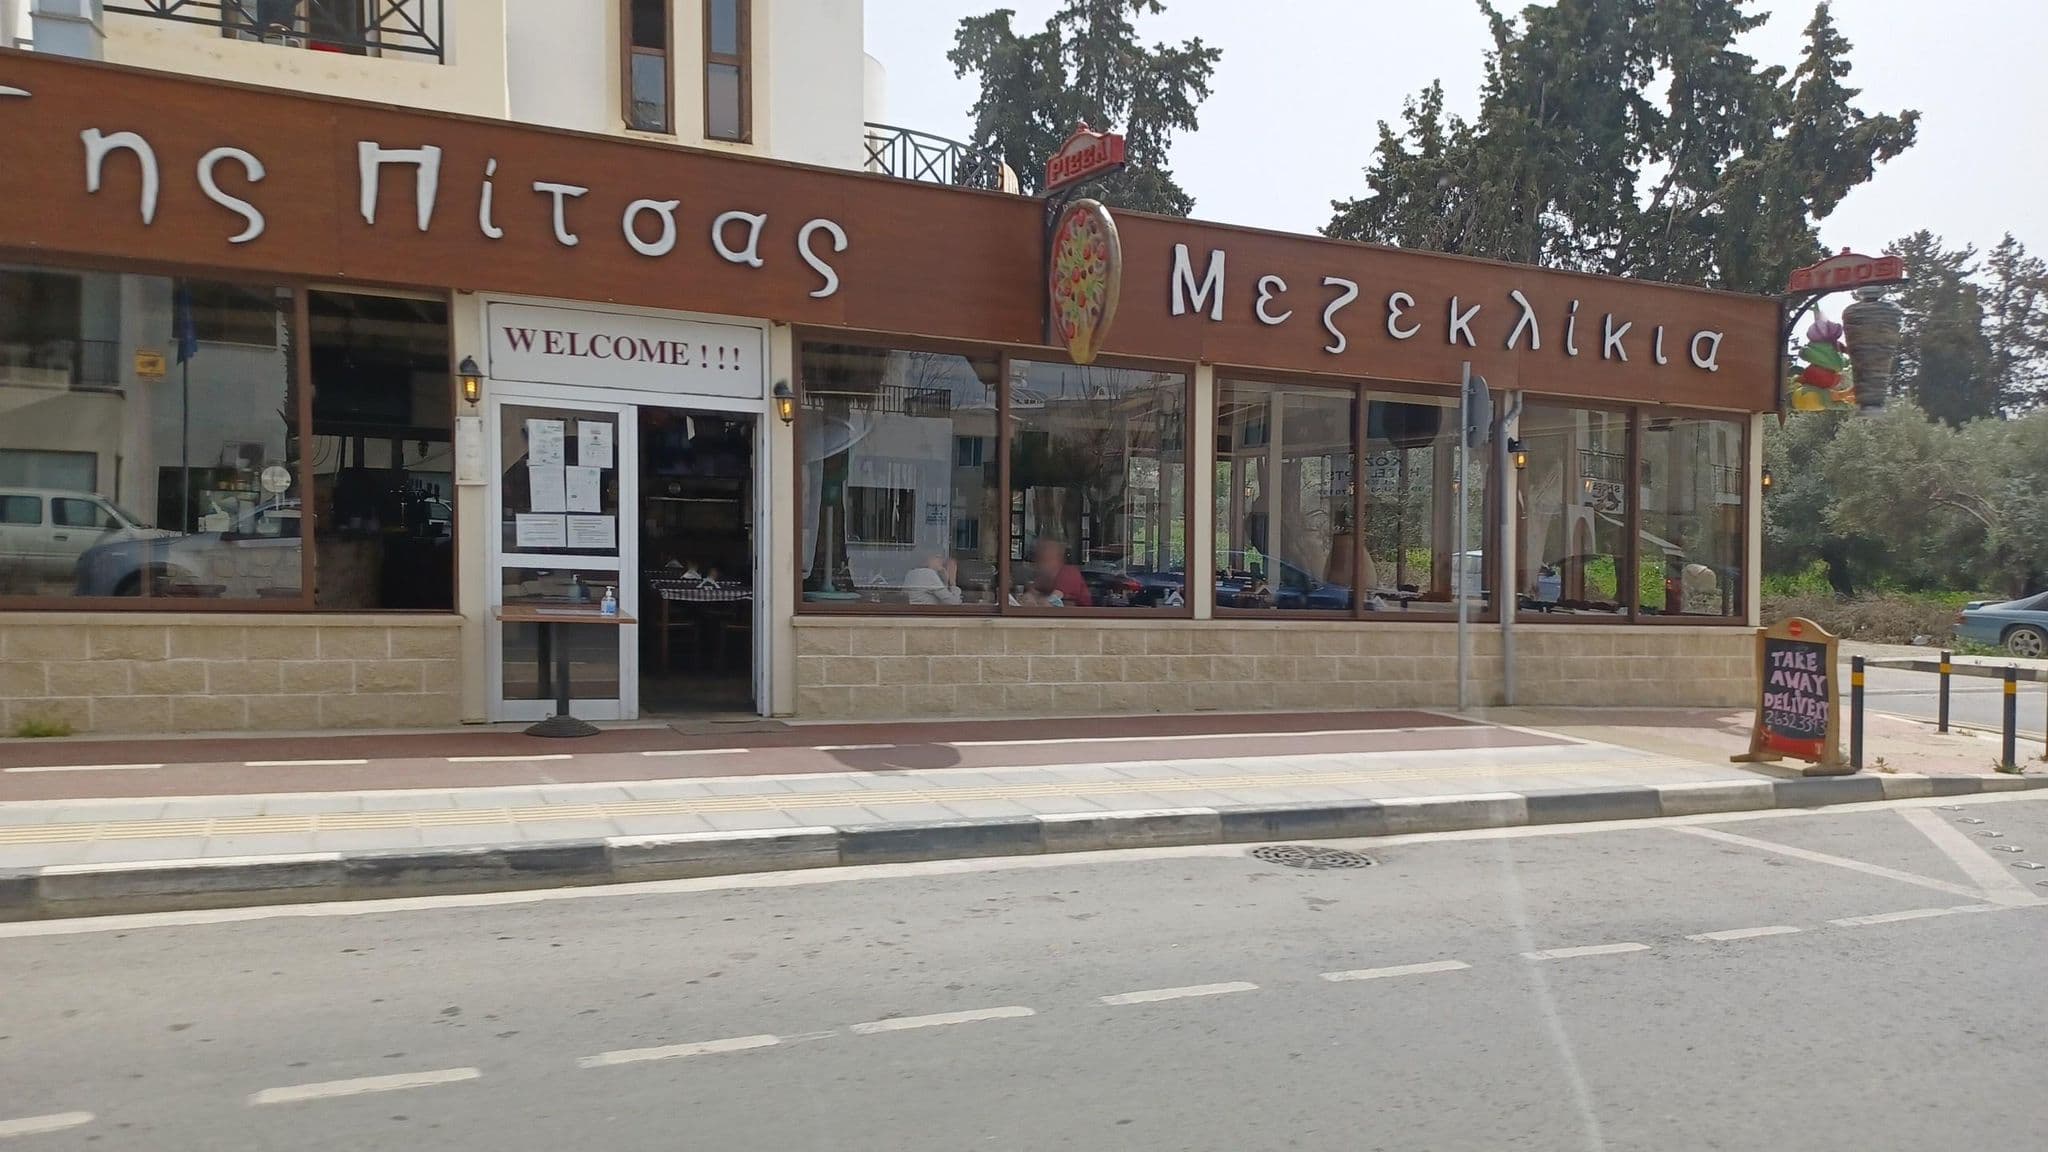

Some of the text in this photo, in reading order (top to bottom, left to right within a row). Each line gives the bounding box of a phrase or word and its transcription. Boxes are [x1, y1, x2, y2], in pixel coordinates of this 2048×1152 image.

[1048, 139, 1107, 184] PIZZA
[0, 85, 848, 298] ης Πίτσας
[1171, 243, 1723, 372] Μεζεκλίκια
[502, 326, 690, 367] WELCOME
[1771, 651, 1818, 671] TAKE
[1770, 670, 1827, 697] AWAY
